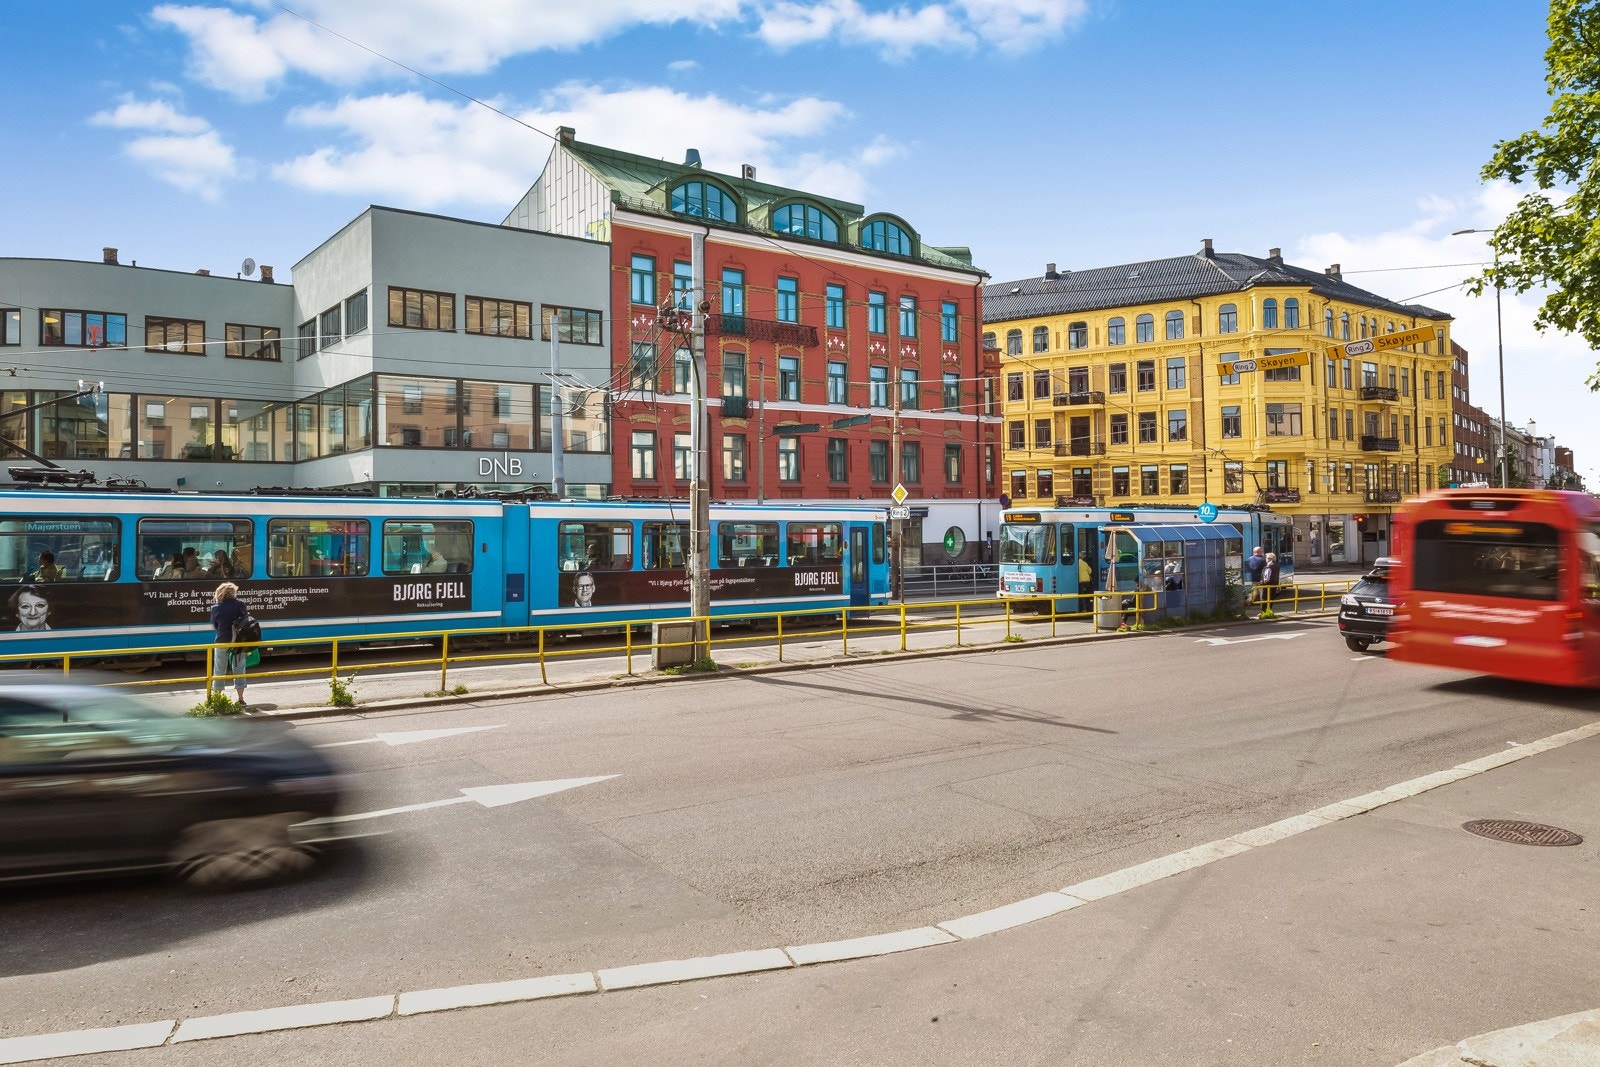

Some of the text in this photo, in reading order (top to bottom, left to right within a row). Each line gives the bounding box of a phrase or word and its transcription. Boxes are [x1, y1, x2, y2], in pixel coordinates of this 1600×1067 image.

[1378, 333, 1419, 348] Skøyen
[1347, 345, 1364, 354] Ring
[1234, 362, 1255, 371] Ring 2
[1261, 357, 1296, 368] Skøyen
[479, 451, 523, 482] DNB
[27, 523, 81, 532] Majorstuen
[820, 571, 840, 585] FJELL
[393, 581, 466, 601] BJØRG FJELL
[167, 598, 204, 606] økonomi,
[263, 596, 273, 604] og
[274, 595, 309, 603] regnskap.
